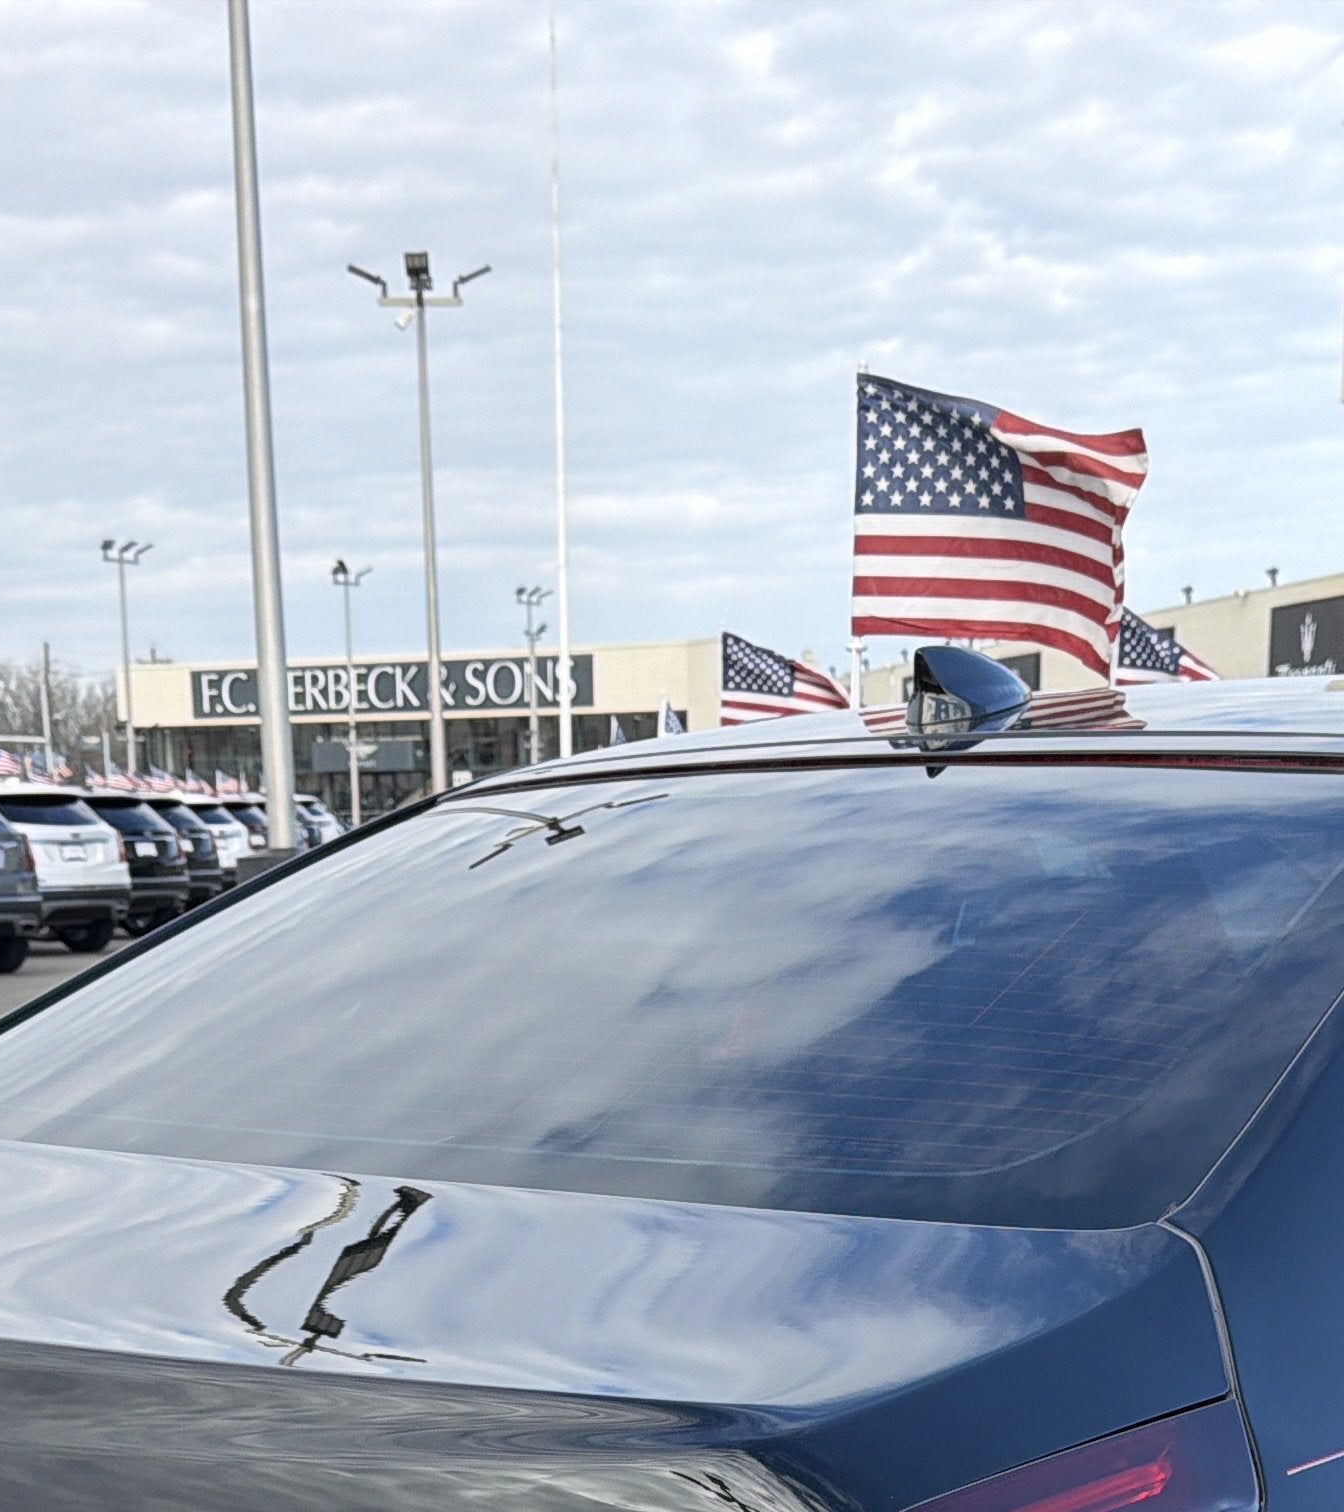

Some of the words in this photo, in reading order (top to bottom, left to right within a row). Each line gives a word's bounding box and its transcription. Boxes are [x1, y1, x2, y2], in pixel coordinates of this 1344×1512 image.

[201, 671, 256, 714] F.C.
[286, 664, 421, 712] ERBECK
[464, 656, 578, 706] SONS
